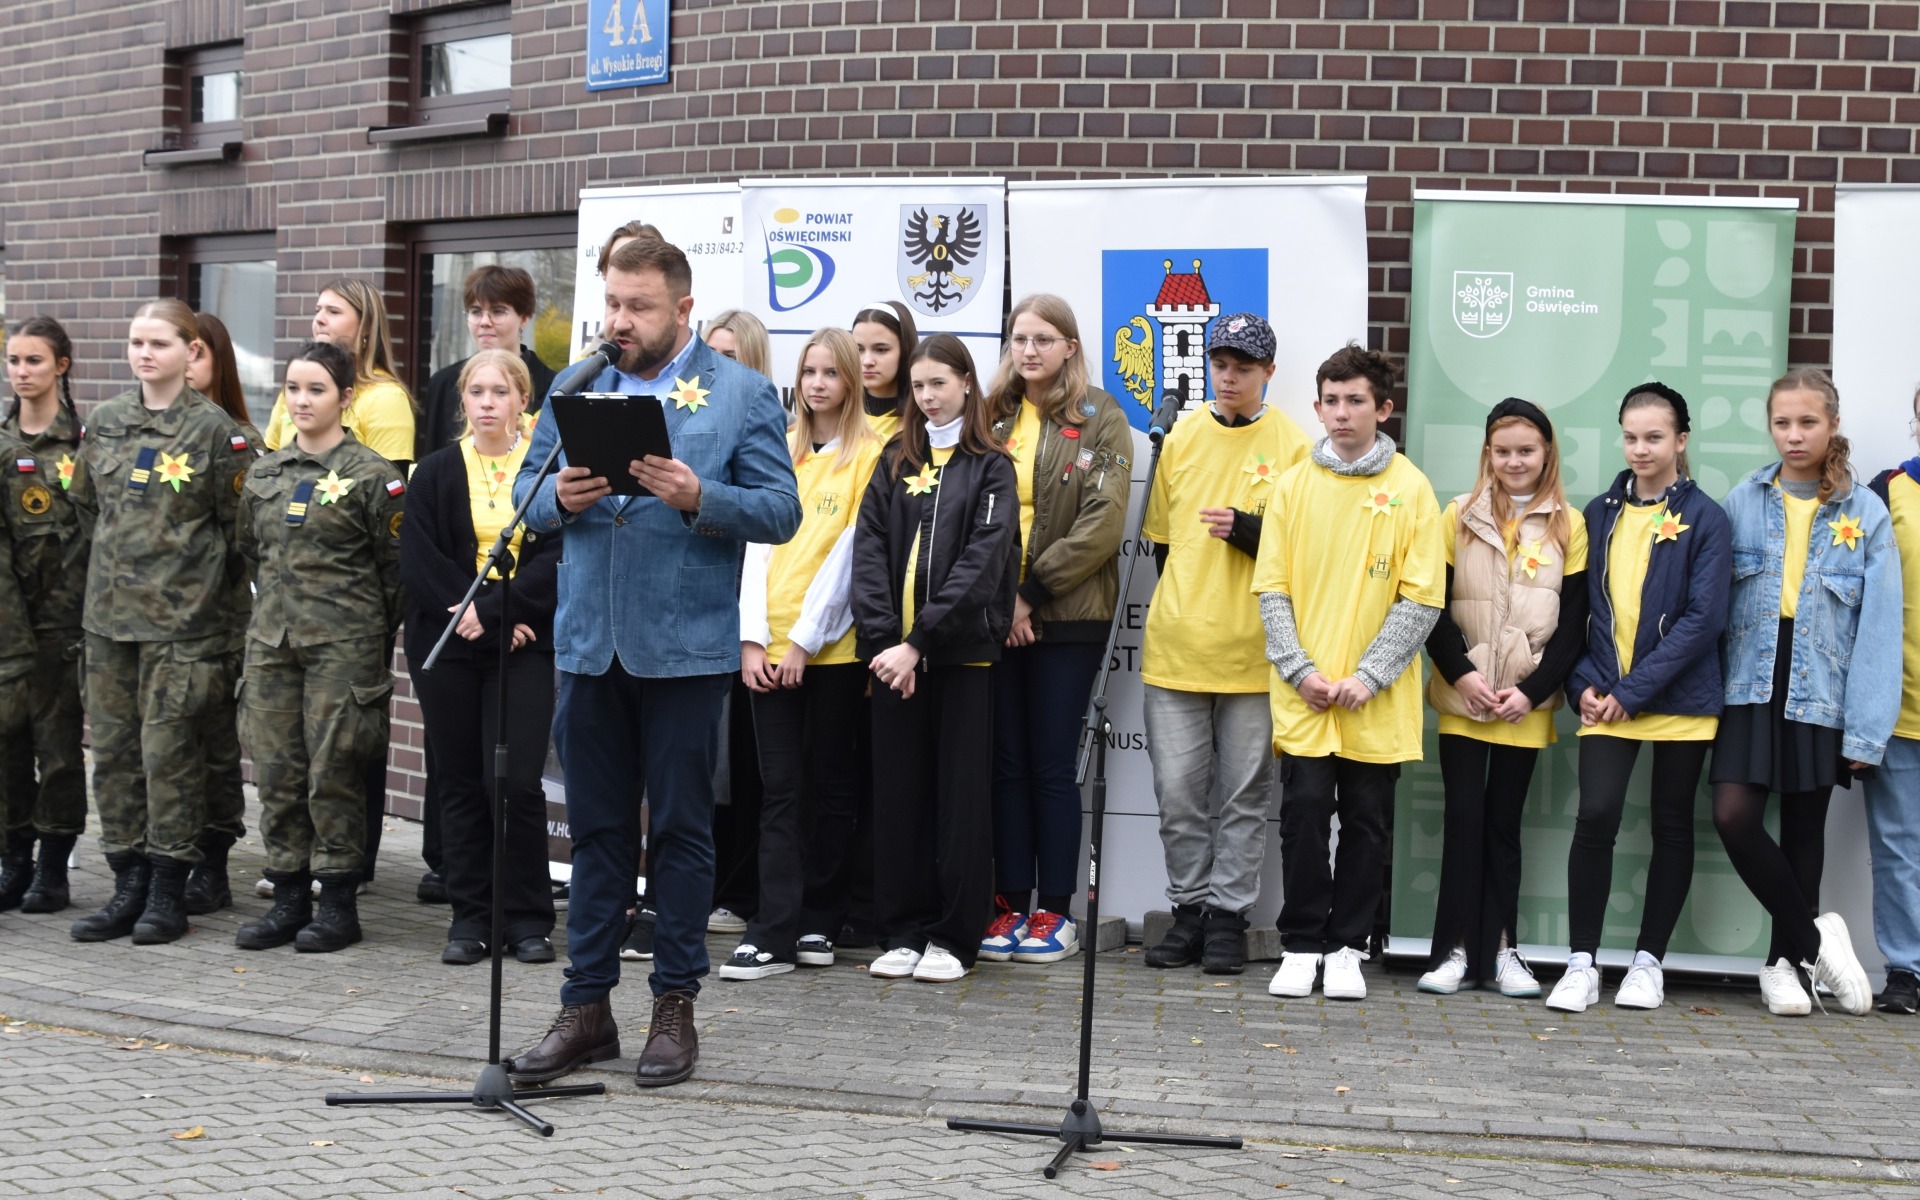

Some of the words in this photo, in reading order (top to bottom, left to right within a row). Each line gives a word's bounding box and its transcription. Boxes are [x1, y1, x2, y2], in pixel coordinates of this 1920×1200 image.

[603, 0, 653, 46] 4A
[591, 58, 601, 75] ul.
[602, 54, 635, 77] Wysokie
[635, 49, 663, 72] Brzegi
[805, 213, 854, 225] POWIAT
[769, 228, 852, 244] OŚWIĘCIMSKI
[686, 243, 703, 255] +48
[1526, 285, 1575, 298] Gmina
[1526, 300, 1598, 316] Oświęcim
